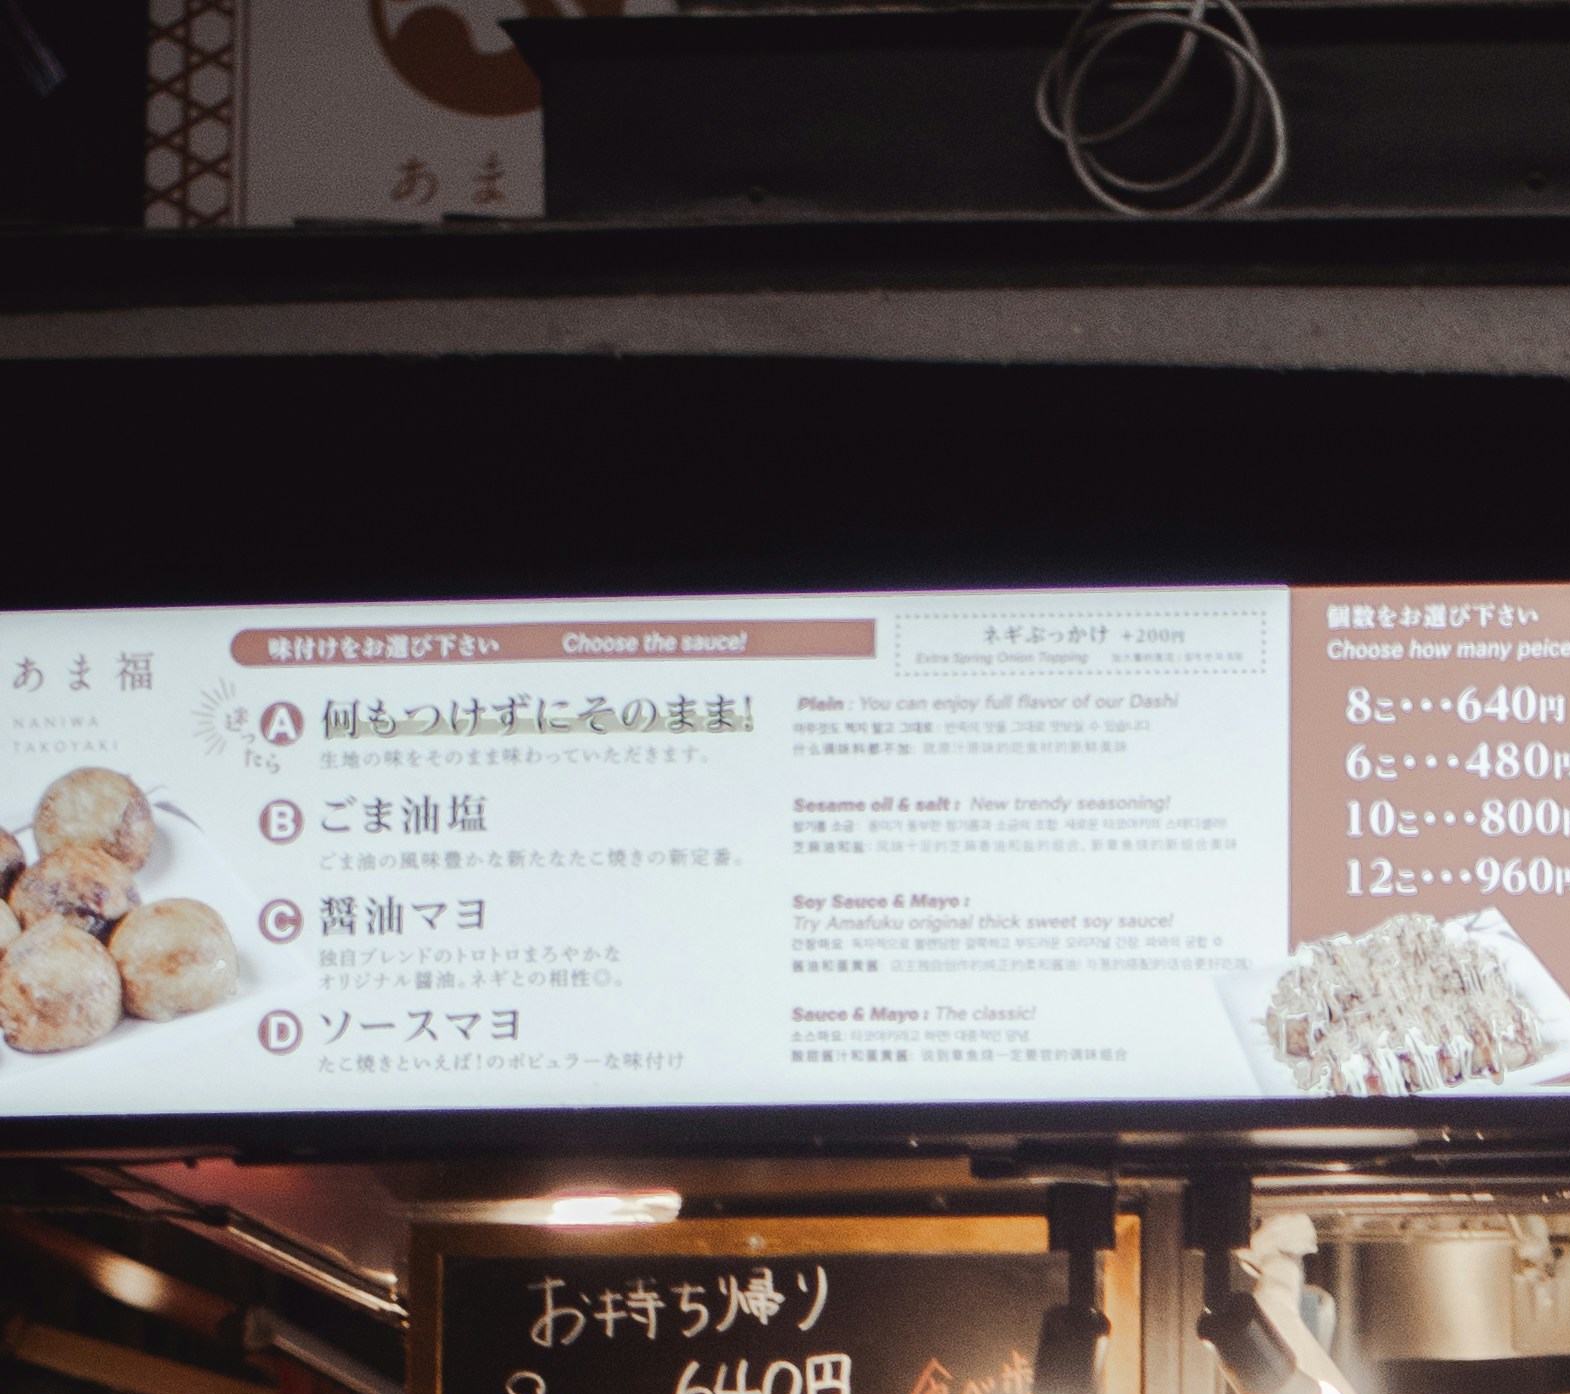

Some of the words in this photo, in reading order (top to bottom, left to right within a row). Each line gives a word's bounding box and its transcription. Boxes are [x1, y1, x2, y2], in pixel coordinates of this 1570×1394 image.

[562, 631, 640, 654] Choose
[643, 630, 678, 652] the
[1326, 638, 1404, 660] Choose
[1408, 638, 1452, 659] how
[1456, 638, 1512, 662] many
[12, 650, 154, 692] あま福
[322, 694, 755, 740] 何もつけずにそのまま!
[931, 697, 980, 714] enjoy
[984, 694, 1013, 710] full
[12, 715, 100, 731] NANIWA
[265, 704, 300, 743] A
[12, 738, 118, 754] TAKOYAKI
[265, 802, 300, 841] B
[320, 795, 488, 835] ごま油塩
[793, 796, 866, 813] Sesame
[1014, 795, 1072, 814] trendy
[320, 897, 486, 937] 醤油マヨ
[793, 894, 825, 911] Soy
[832, 893, 888, 910] Sauce
[263, 903, 299, 941] C
[320, 1008, 521, 1042] ソースマヨ
[792, 1006, 848, 1022] Sauce
[264, 1014, 301, 1050] D
[527, 1265, 829, 1347] お持ち帰り
